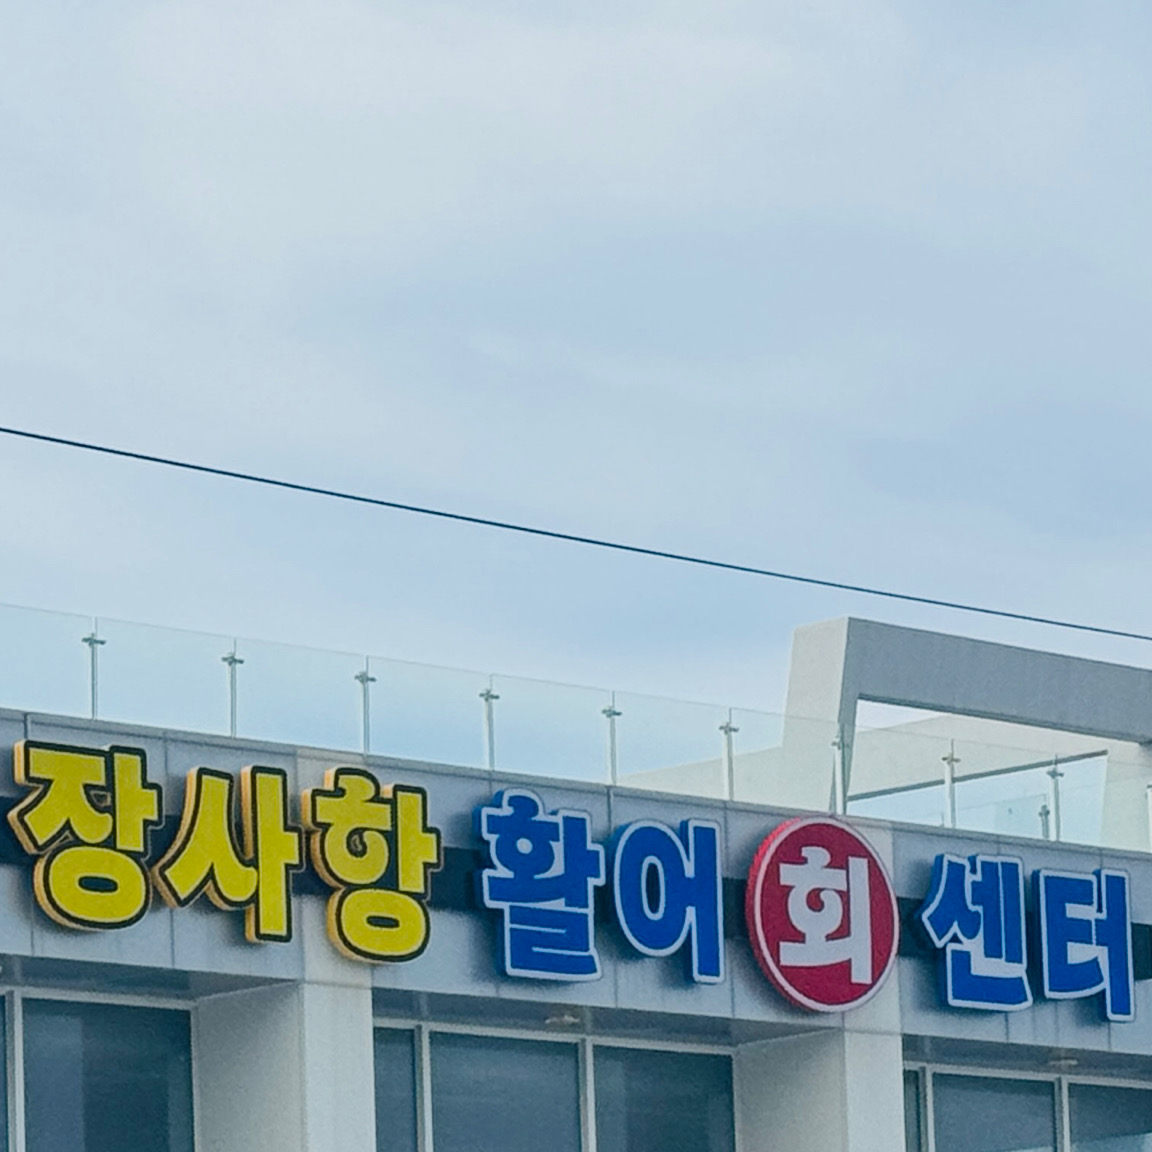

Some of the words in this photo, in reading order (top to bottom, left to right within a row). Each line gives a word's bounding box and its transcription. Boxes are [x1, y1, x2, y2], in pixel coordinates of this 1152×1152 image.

[8, 739, 443, 963] 장사항
[474, 789, 725, 984] 활어
[921, 853, 1136, 1022] 센터
